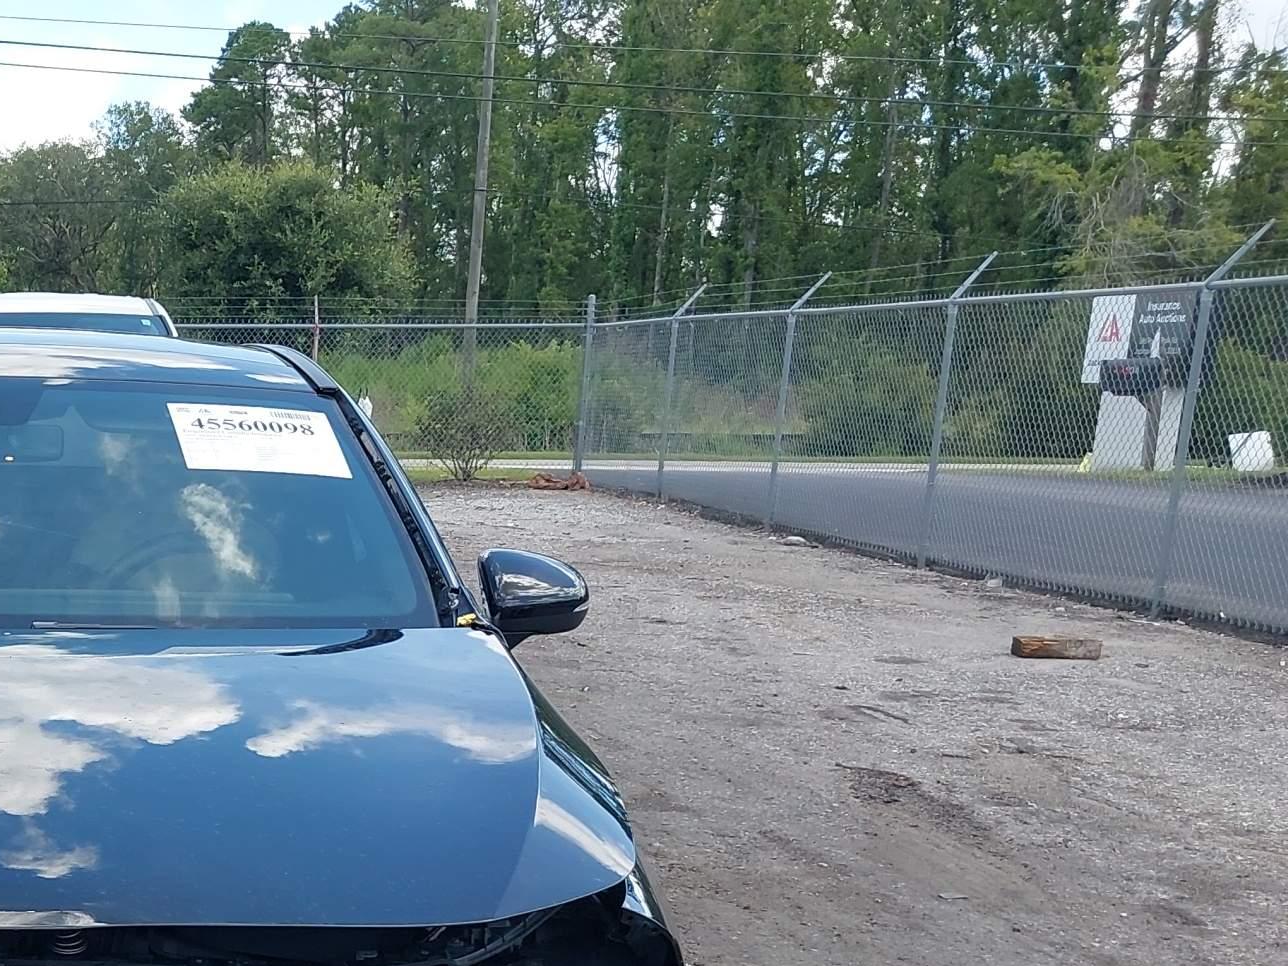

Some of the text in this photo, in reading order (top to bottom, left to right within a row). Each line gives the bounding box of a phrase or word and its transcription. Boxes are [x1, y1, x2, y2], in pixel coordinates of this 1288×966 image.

[1147, 301, 1181, 311] Insurance
[1138, 311, 1187, 324] Auto Auctions
[191, 417, 315, 436] 45560098
